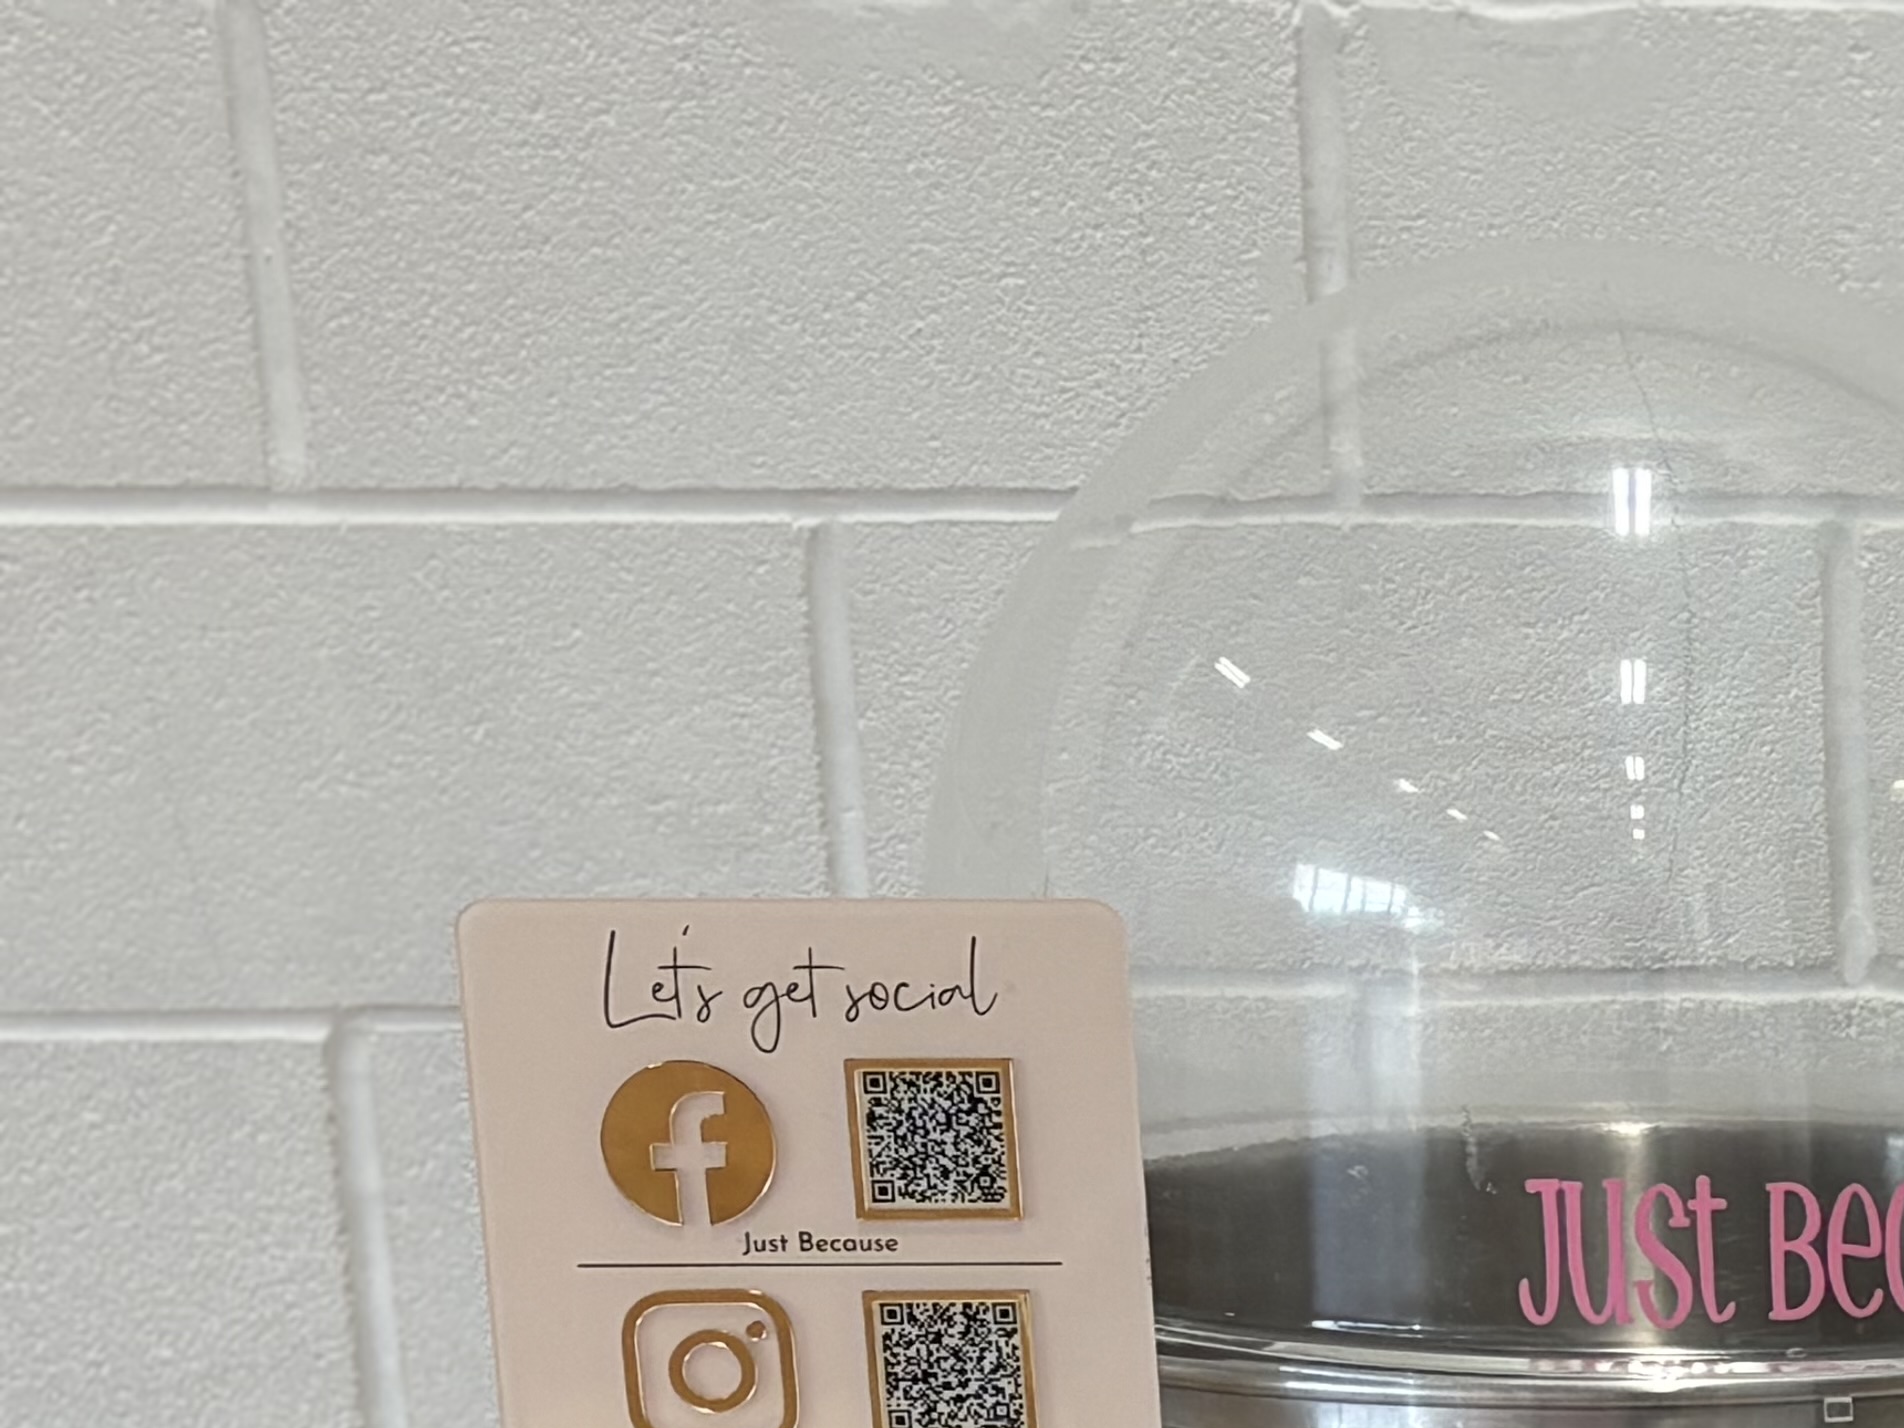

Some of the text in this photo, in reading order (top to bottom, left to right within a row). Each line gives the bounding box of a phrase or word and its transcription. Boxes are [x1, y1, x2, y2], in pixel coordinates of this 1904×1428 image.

[604, 925, 998, 1053] Let's get social
[743, 1232, 899, 1255] Just Because
